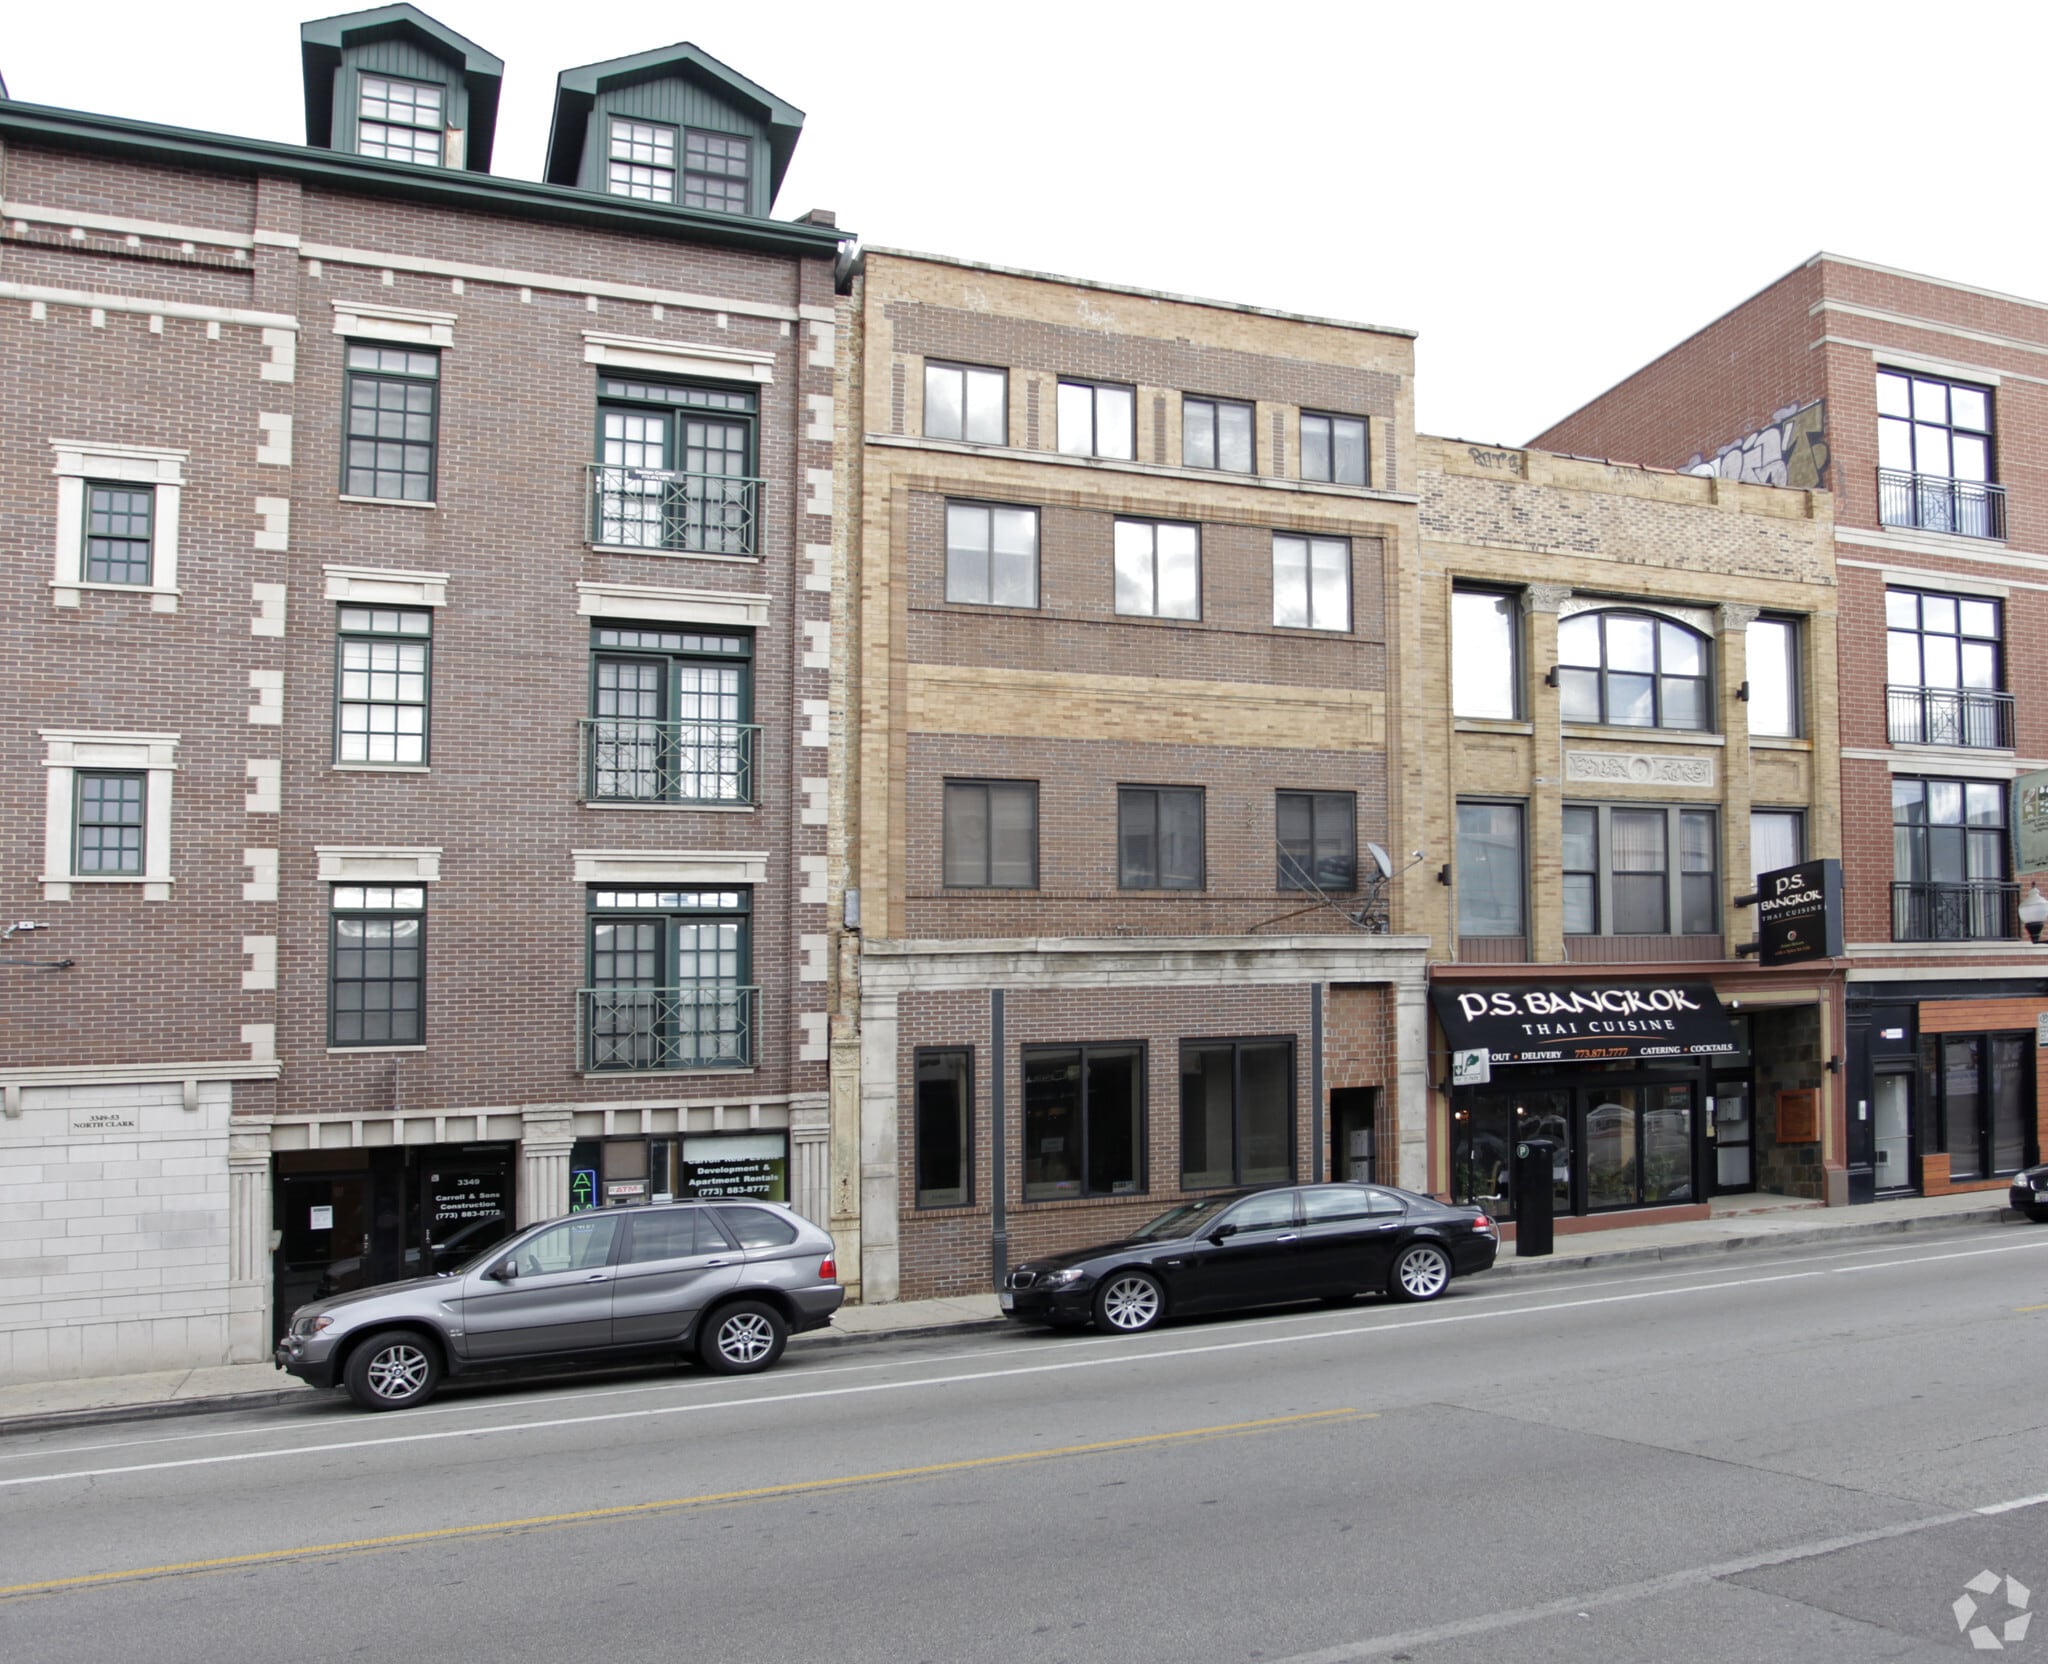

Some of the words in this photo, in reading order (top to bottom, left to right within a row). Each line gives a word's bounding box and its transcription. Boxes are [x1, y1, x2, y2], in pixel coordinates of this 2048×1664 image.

[1776, 874, 1805, 895] P.S.
[1761, 890, 1822, 911] BANGKOK
[1762, 912, 1782, 921] THAI
[1785, 904, 1822, 917] CUISINE
[1457, 992, 1524, 1022] P.S.
[1523, 989, 1700, 1017] BANGKOK
[1522, 1023, 1577, 1035] THAI
[1588, 1020, 1675, 1033] CUISINE
[1491, 1053, 1511, 1061] OUT
[1521, 1051, 1562, 1060] DELIVERY
[1574, 1048, 1628, 1058] 773.871.7777
[1640, 1046, 1680, 1055] CATERING
[1690, 1044, 1733, 1053] COCKTAILS
[697, 1164, 759, 1175] Development
[457, 1178, 480, 1186] 3349
[688, 1176, 740, 1186] Apartment
[743, 1174, 779, 1182] Rentals
[435, 1193, 466, 1201] Carroll
[698, 1187, 723, 1197] (773)
[726, 1185, 770, 1194] 883-8772
[440, 1201, 496, 1210] Construction
[435, 1211, 458, 1221] (773)
[461, 1209, 501, 1218] 883-8772
